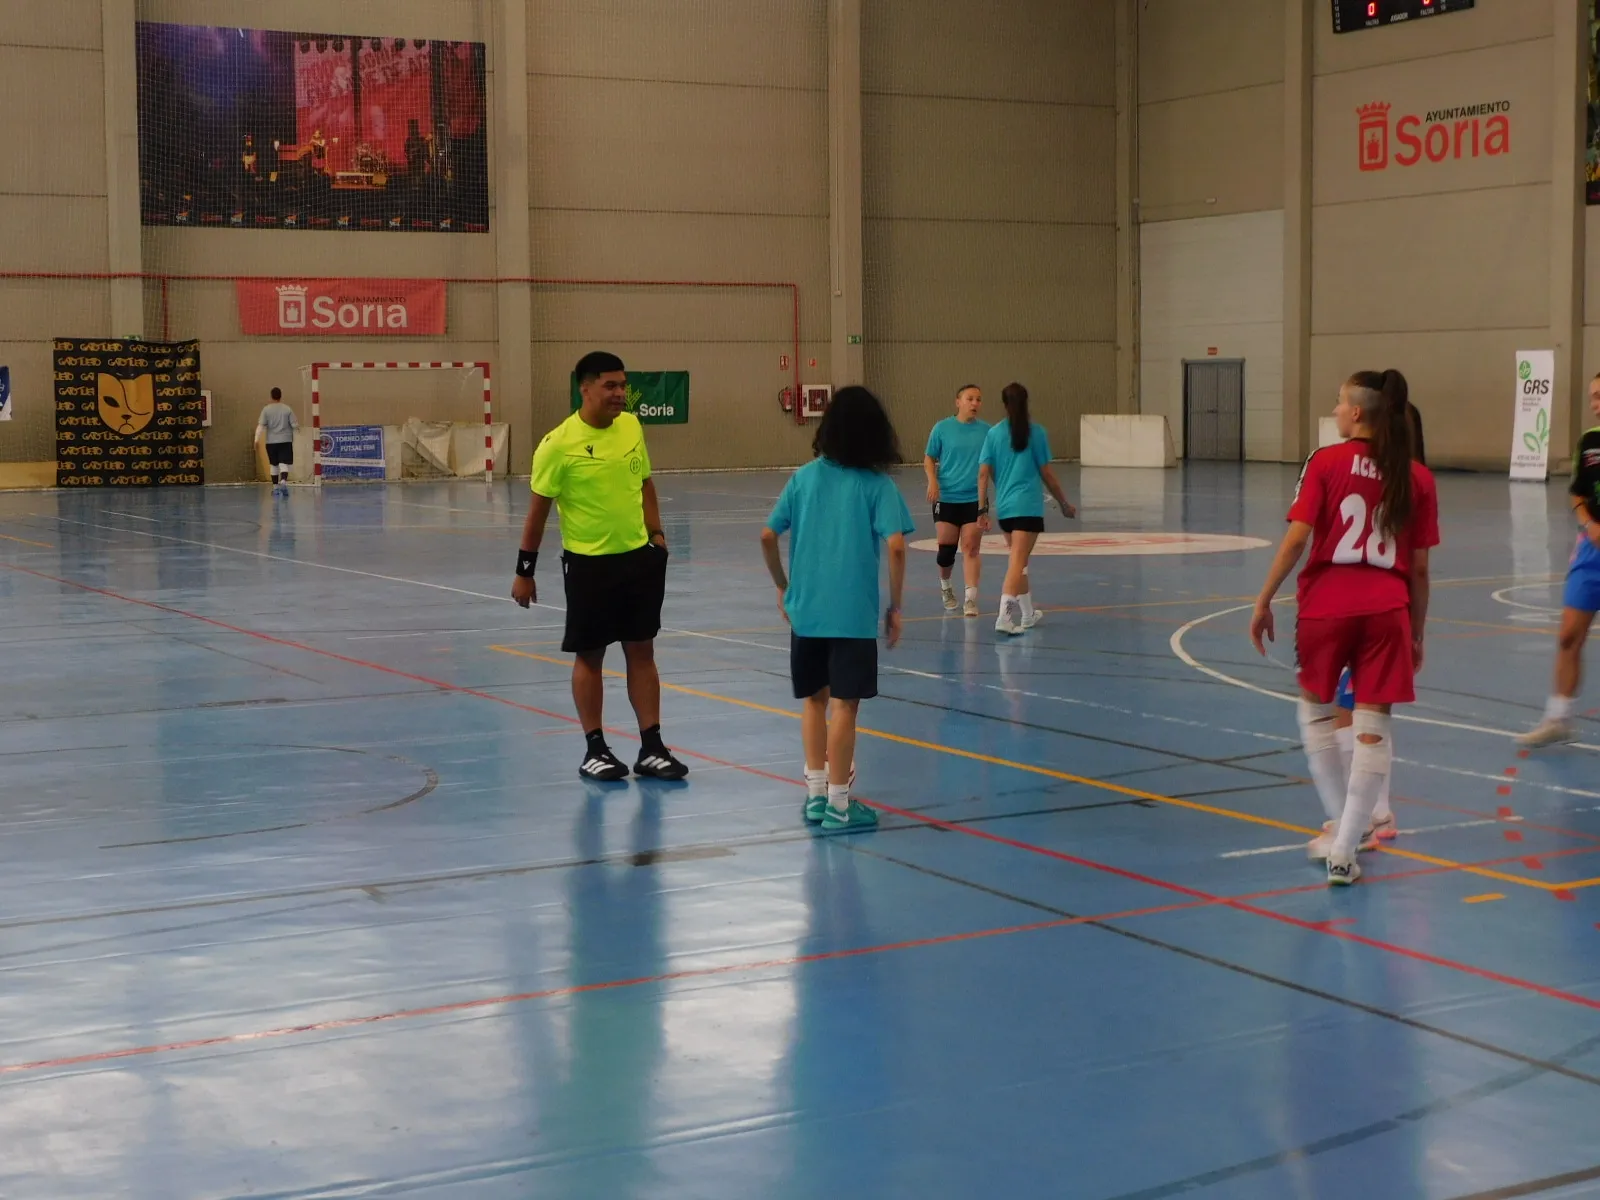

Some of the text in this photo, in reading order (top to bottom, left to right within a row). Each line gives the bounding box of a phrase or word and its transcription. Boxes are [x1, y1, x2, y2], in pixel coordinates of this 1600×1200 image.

[1367, 2, 1375, 16] 0
[1425, 100, 1511, 123] AYUNTAMIENTO
[1394, 115, 1512, 166] Soria
[311, 295, 408, 328] Soria
[1523, 379, 1550, 395] GRS
[639, 403, 674, 416] Soria
[1350, 453, 1383, 481] ACE
[1331, 493, 1396, 570] 28
